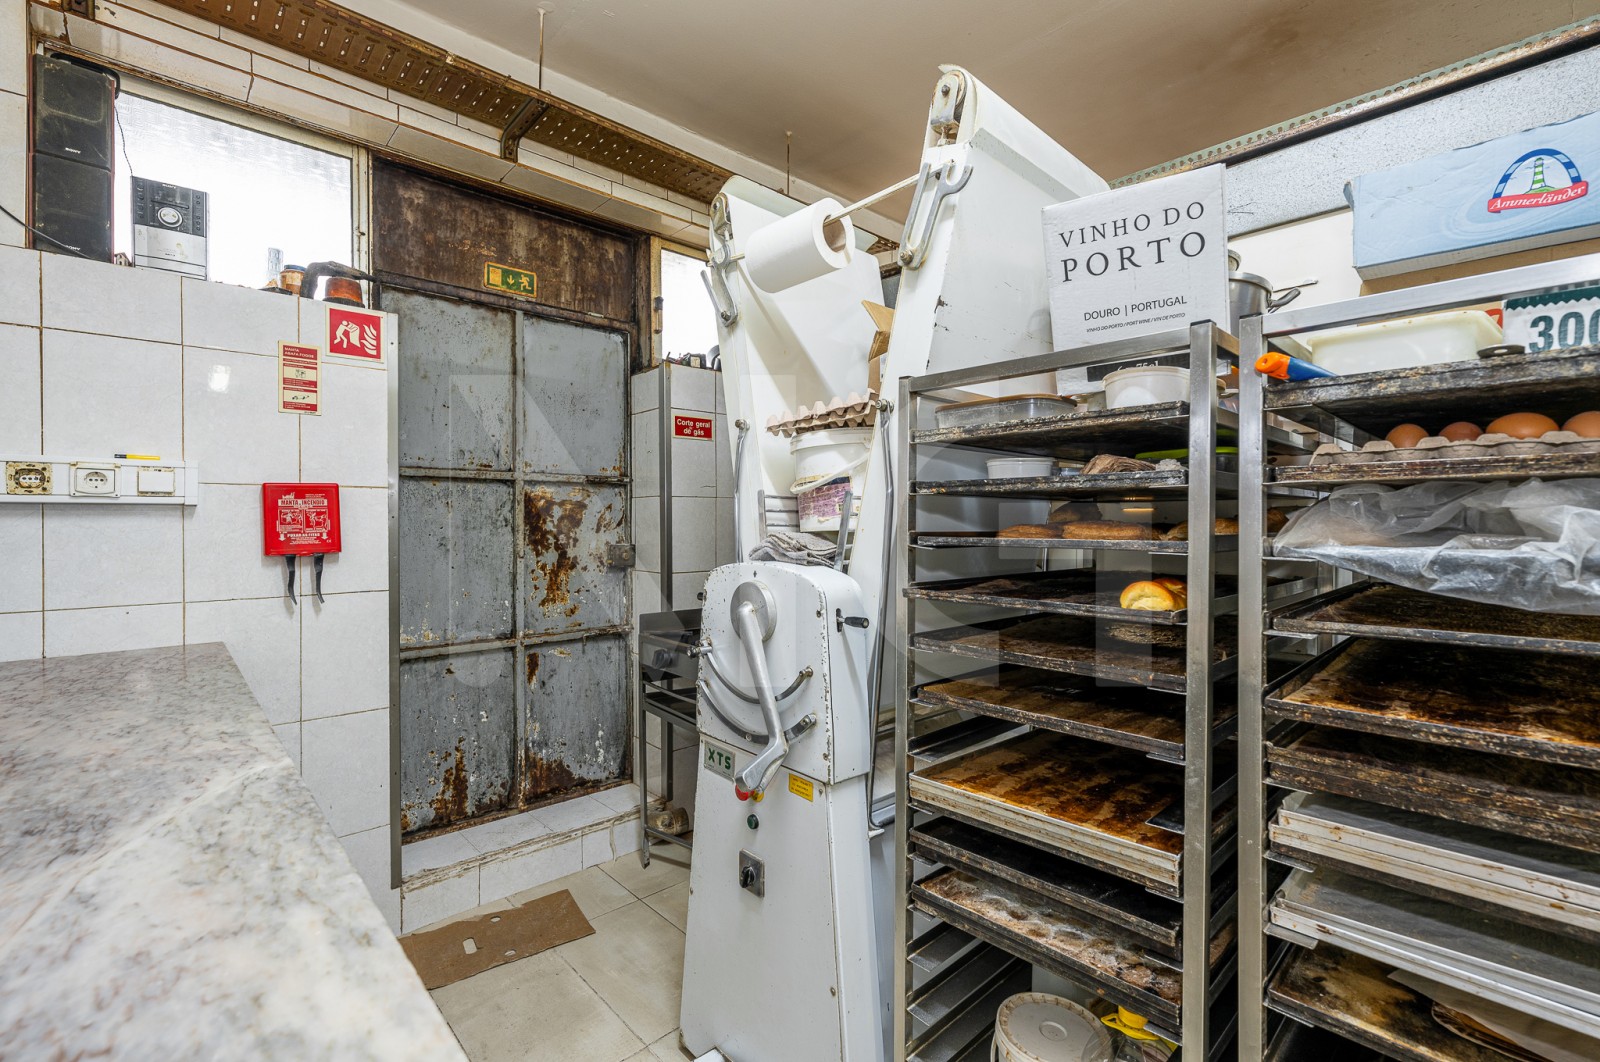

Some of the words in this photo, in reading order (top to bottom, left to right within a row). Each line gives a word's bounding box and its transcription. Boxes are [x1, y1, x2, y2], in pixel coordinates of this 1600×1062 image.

[1490, 186, 1585, 209] Ammerländer
[1058, 213, 1151, 248] VINHO
[1163, 201, 1205, 227] DO
[1060, 231, 1206, 283] PORTO
[1083, 307, 1121, 321] DOURO
[1131, 295, 1188, 313] PORTUGAL
[677, 418, 693, 427] Corte
[707, 747, 732, 770] XTS
